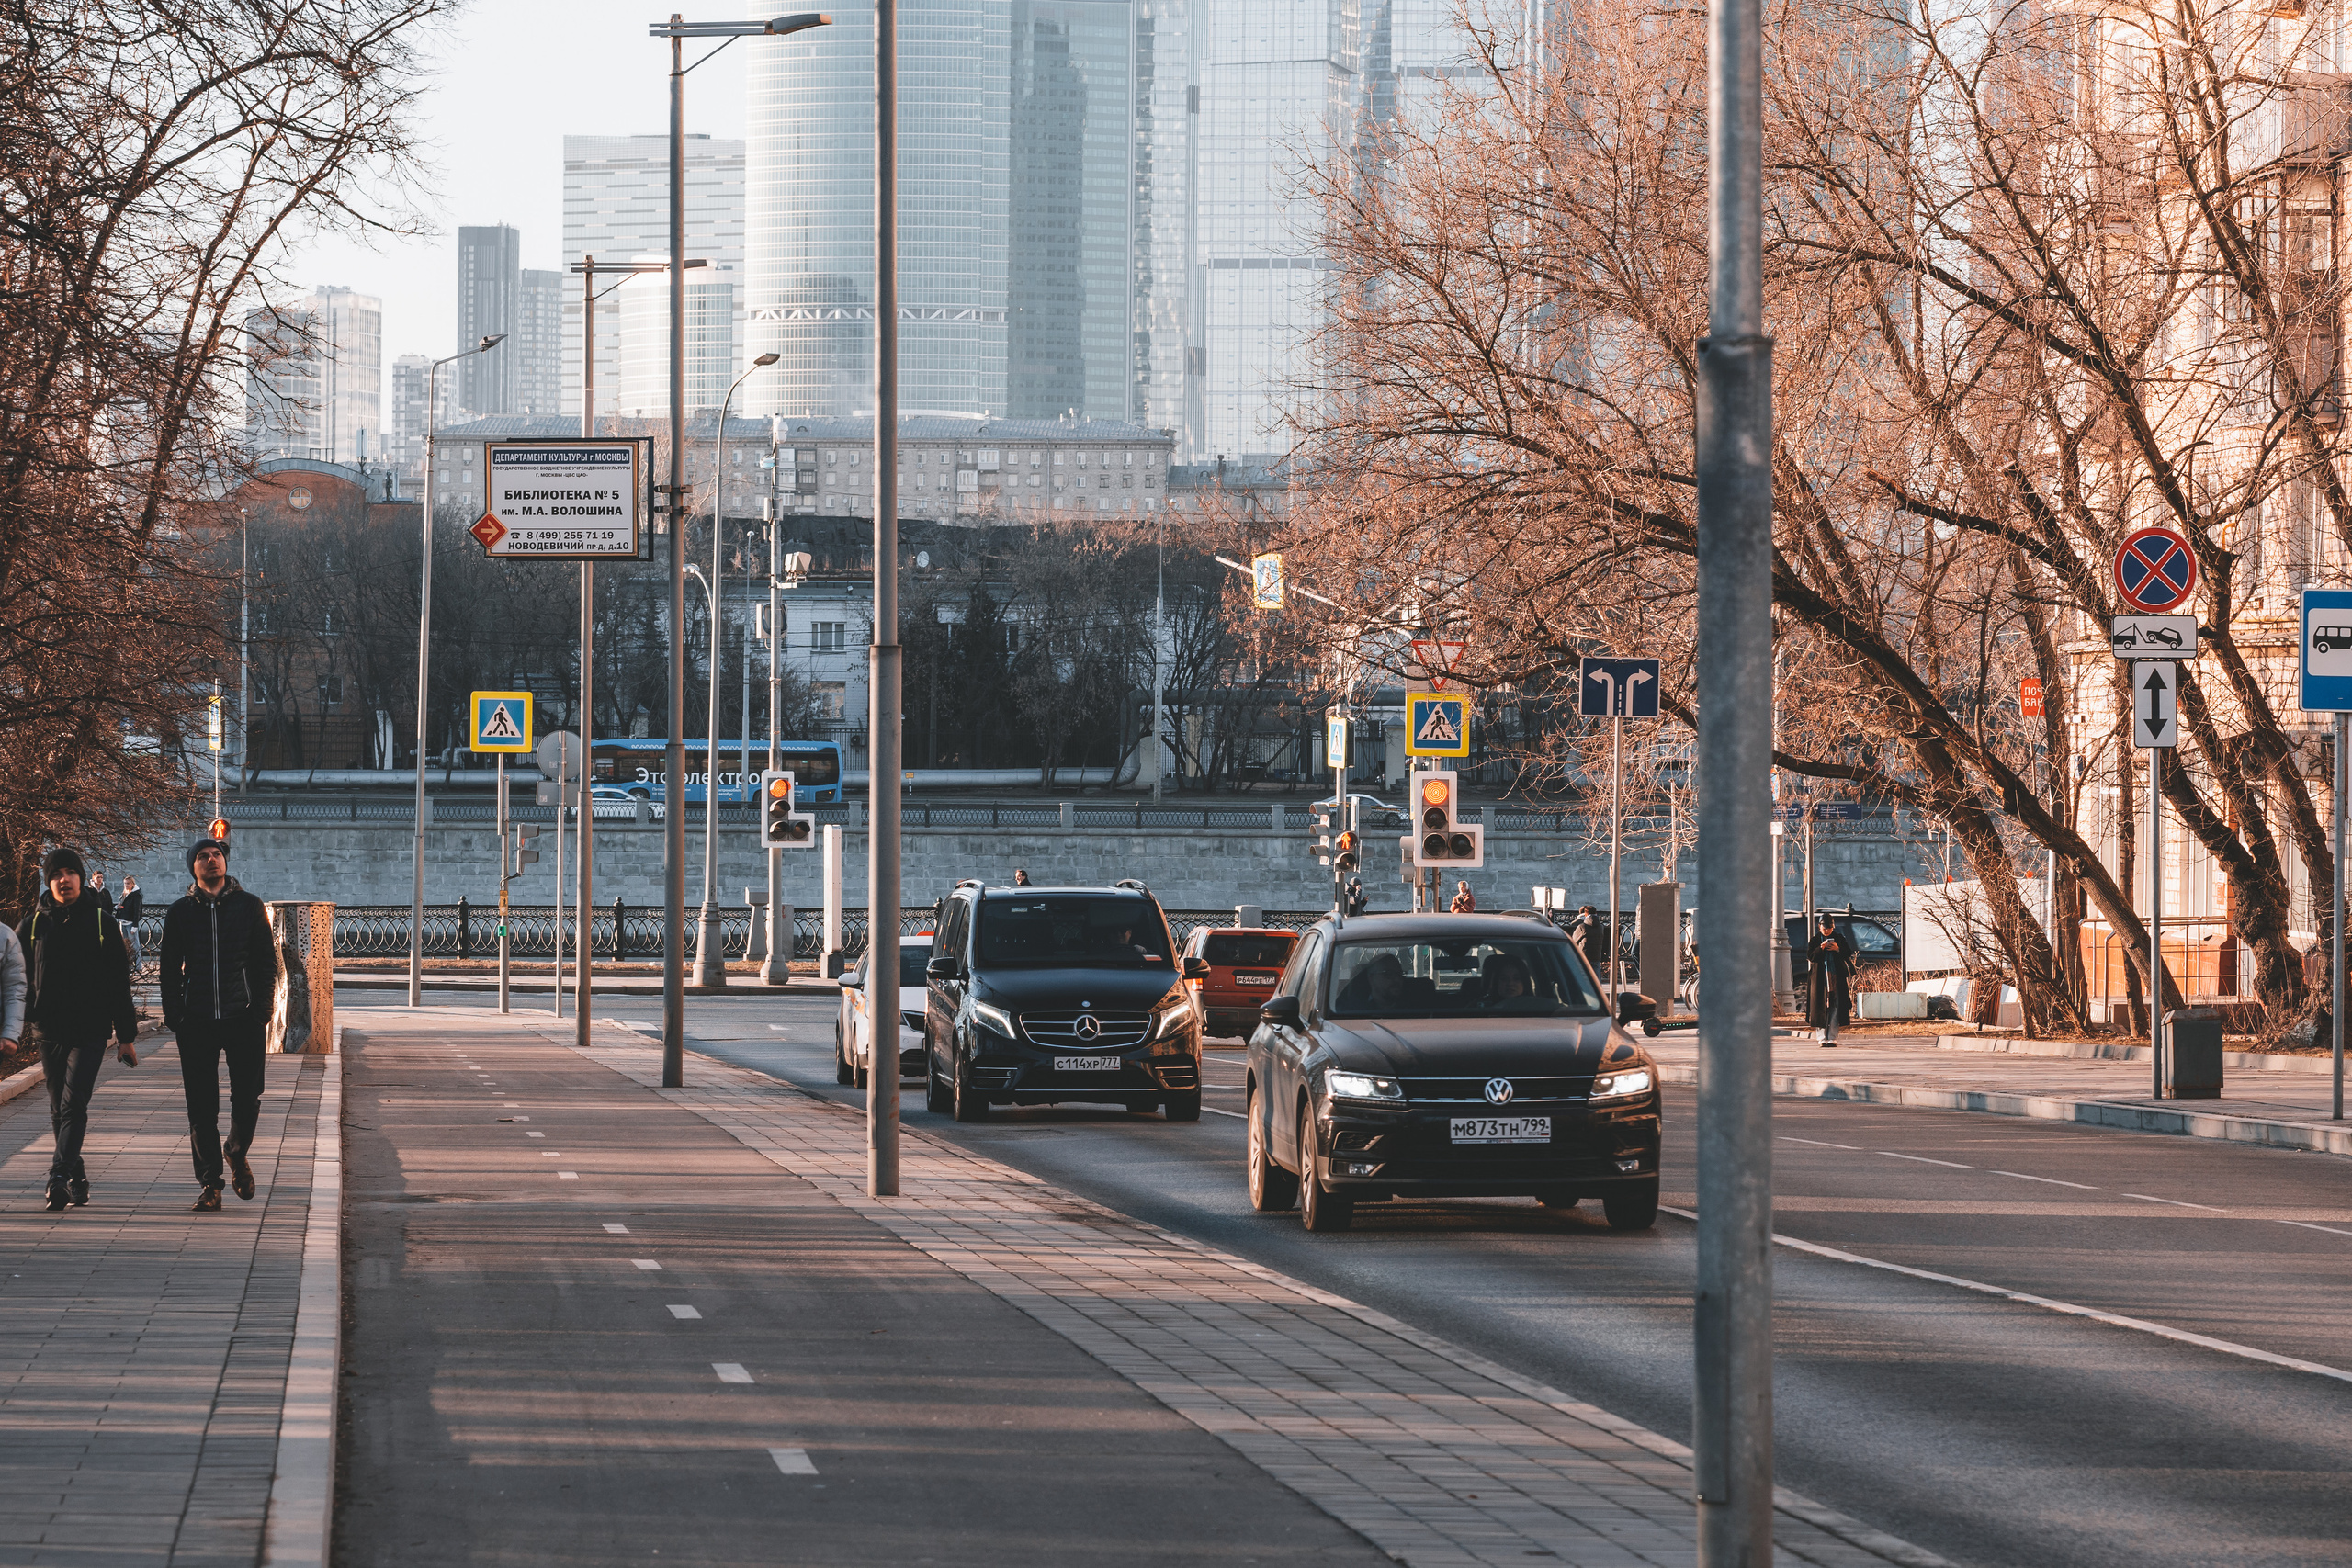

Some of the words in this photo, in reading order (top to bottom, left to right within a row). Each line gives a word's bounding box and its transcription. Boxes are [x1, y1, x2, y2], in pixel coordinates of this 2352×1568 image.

[494, 453, 548, 463] ДЕПАРТАМЕНТ
[548, 453, 588, 462] КУЛЬТУРЫ
[504, 490, 592, 500] БИБЛИОТЕКА
[594, 490, 608, 500] №
[611, 490, 620, 500] 5
[501, 508, 519, 516] им.
[522, 506, 548, 516] М.А.
[551, 506, 623, 516] ВОЛОШИНА
[526, 531, 534, 540] 8
[536, 531, 562, 541] (499)
[563, 531, 614, 540] 255-71-19
[508, 540, 584, 551] НОВОДЕВИЧИЙ
[2024, 686, 2043, 696] ПОЧ
[1102, 1057, 1117, 1066] 777
[1454, 1120, 1519, 1136] М873ТН
[1521, 1119, 1546, 1131] 799
